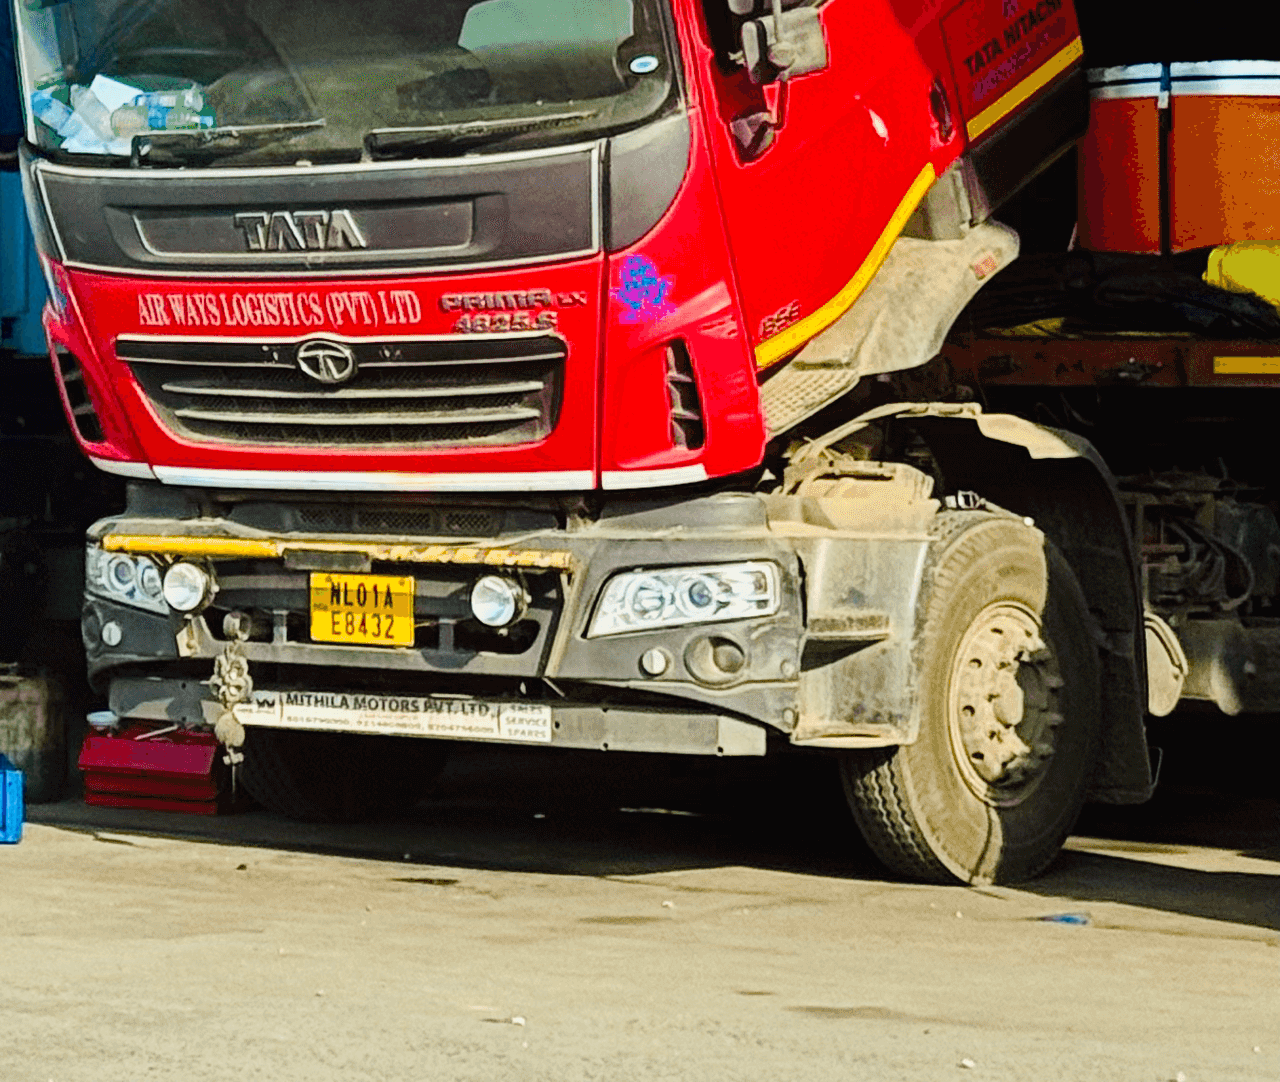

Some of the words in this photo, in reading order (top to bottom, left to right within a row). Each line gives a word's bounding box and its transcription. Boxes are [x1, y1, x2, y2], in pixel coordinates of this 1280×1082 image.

[234, 209, 367, 250] TATA
[220, 292, 325, 326] LOGISTICS
[326, 291, 378, 329] (PVT)
[379, 290, 422, 324] LTD
[441, 289, 552, 312] PRIMA
[329, 581, 394, 609] NL01A
[331, 610, 395, 640] E8432
[286, 693, 350, 709] MITHILA
[353, 697, 420, 714] MOTORS
